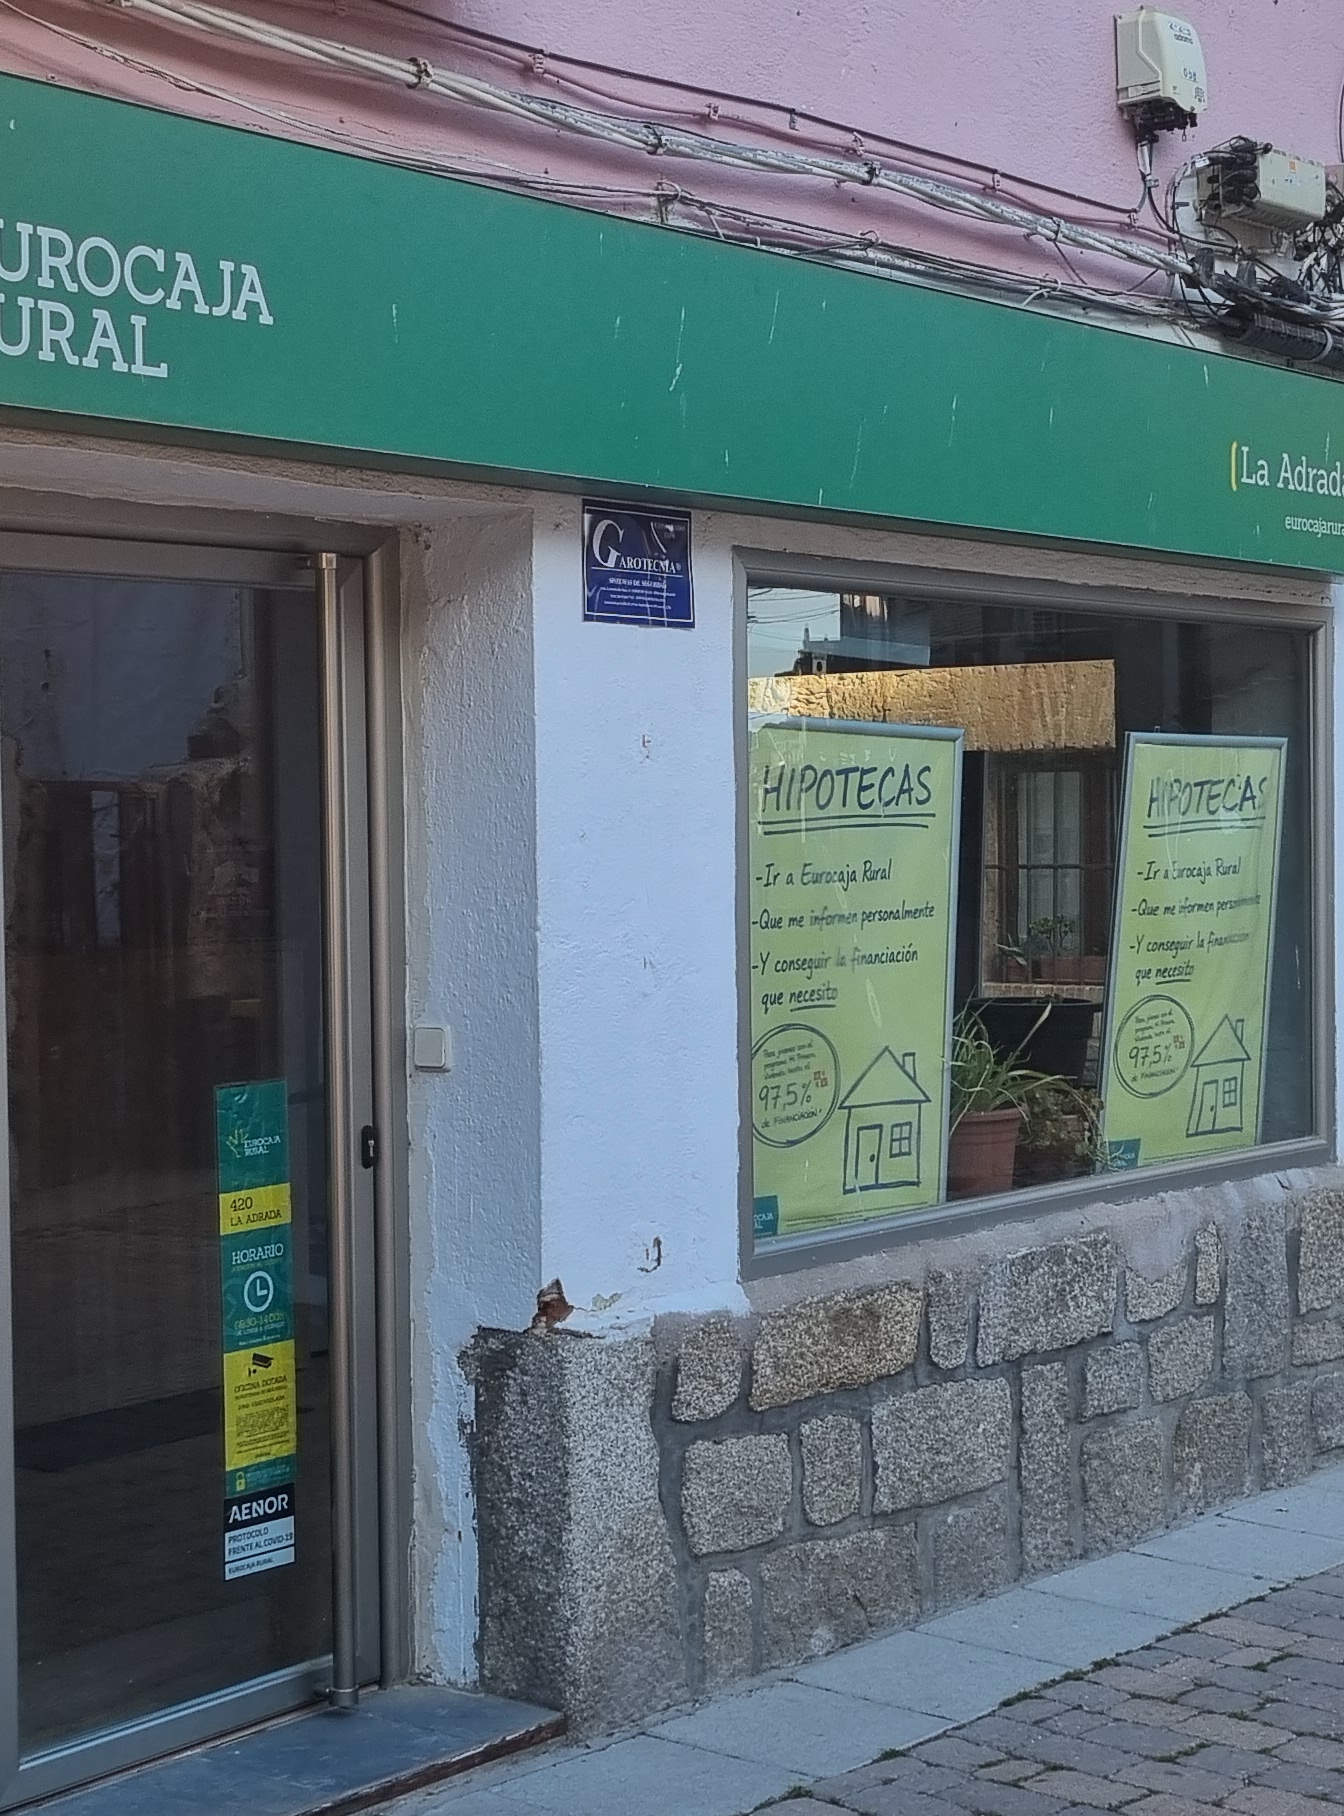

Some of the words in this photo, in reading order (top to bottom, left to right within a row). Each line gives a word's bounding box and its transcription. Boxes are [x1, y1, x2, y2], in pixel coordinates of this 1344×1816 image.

[761, 763, 933, 813] HIPOTECAS
[1147, 774, 1267, 818] HIPOTECAS
[786, 872, 794, 886] a
[800, 861, 858, 892] Eurocaja
[861, 858, 892, 882] Rural
[1164, 868, 1170, 880] a
[1172, 858, 1213, 884] Eurocaja
[1215, 856, 1242, 876] Rural
[788, 915, 805, 929] me
[809, 906, 857, 931] informen
[861, 900, 935, 930] personalmente
[1163, 905, 1176, 916] me
[1178, 897, 1215, 918] informen
[1146, 935, 1193, 959] conseguir
[1196, 930, 1205, 950] la
[774, 952, 833, 980] conseguir
[835, 948, 847, 968] la
[850, 943, 918, 973] financiación
[1135, 966, 1152, 986] que
[1155, 959, 1195, 980] necesito
[761, 991, 783, 1014] que
[789, 980, 838, 1007] necesito
[1129, 1043, 1172, 1069] 97,5%
[759, 1080, 812, 1111] 97,5%
[244, 1135, 281, 1148] EUROCAJA
[244, 1146, 269, 1157] RURAL
[230, 1196, 253, 1212] 420
[230, 1216, 243, 1227] LA
[246, 1209, 282, 1224] ADRADA
[231, 1243, 284, 1265] HORARIO
[228, 1493, 289, 1524] AENOR
[228, 1526, 269, 1544] PROTOCOLO
[228, 1542, 254, 1556] FRENTE
[255, 1541, 264, 1550] AL
[263, 1532, 293, 1548] COVID-19
